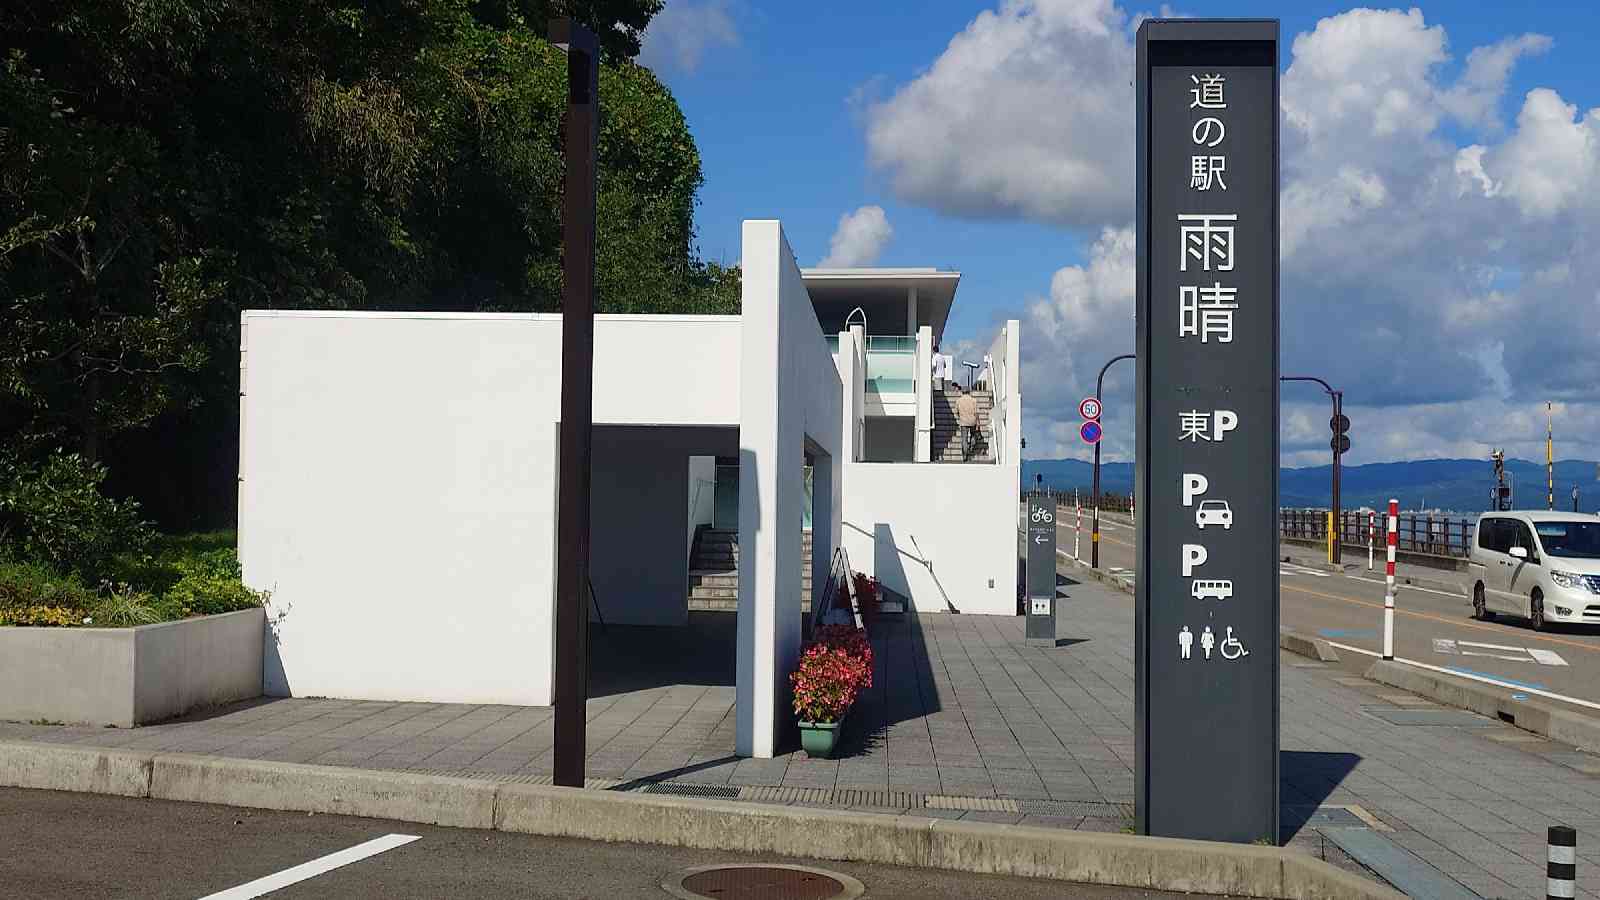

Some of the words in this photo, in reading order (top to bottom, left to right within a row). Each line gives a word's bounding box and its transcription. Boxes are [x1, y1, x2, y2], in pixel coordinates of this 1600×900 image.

[1190, 73, 1227, 191] 道の駅
[1177, 213, 1239, 344] 雨晴
[1085, 403, 1097, 415] 50
[1178, 409, 1238, 442] 東P
[1182, 473, 1208, 506] P
[1182, 544, 1208, 576] P
